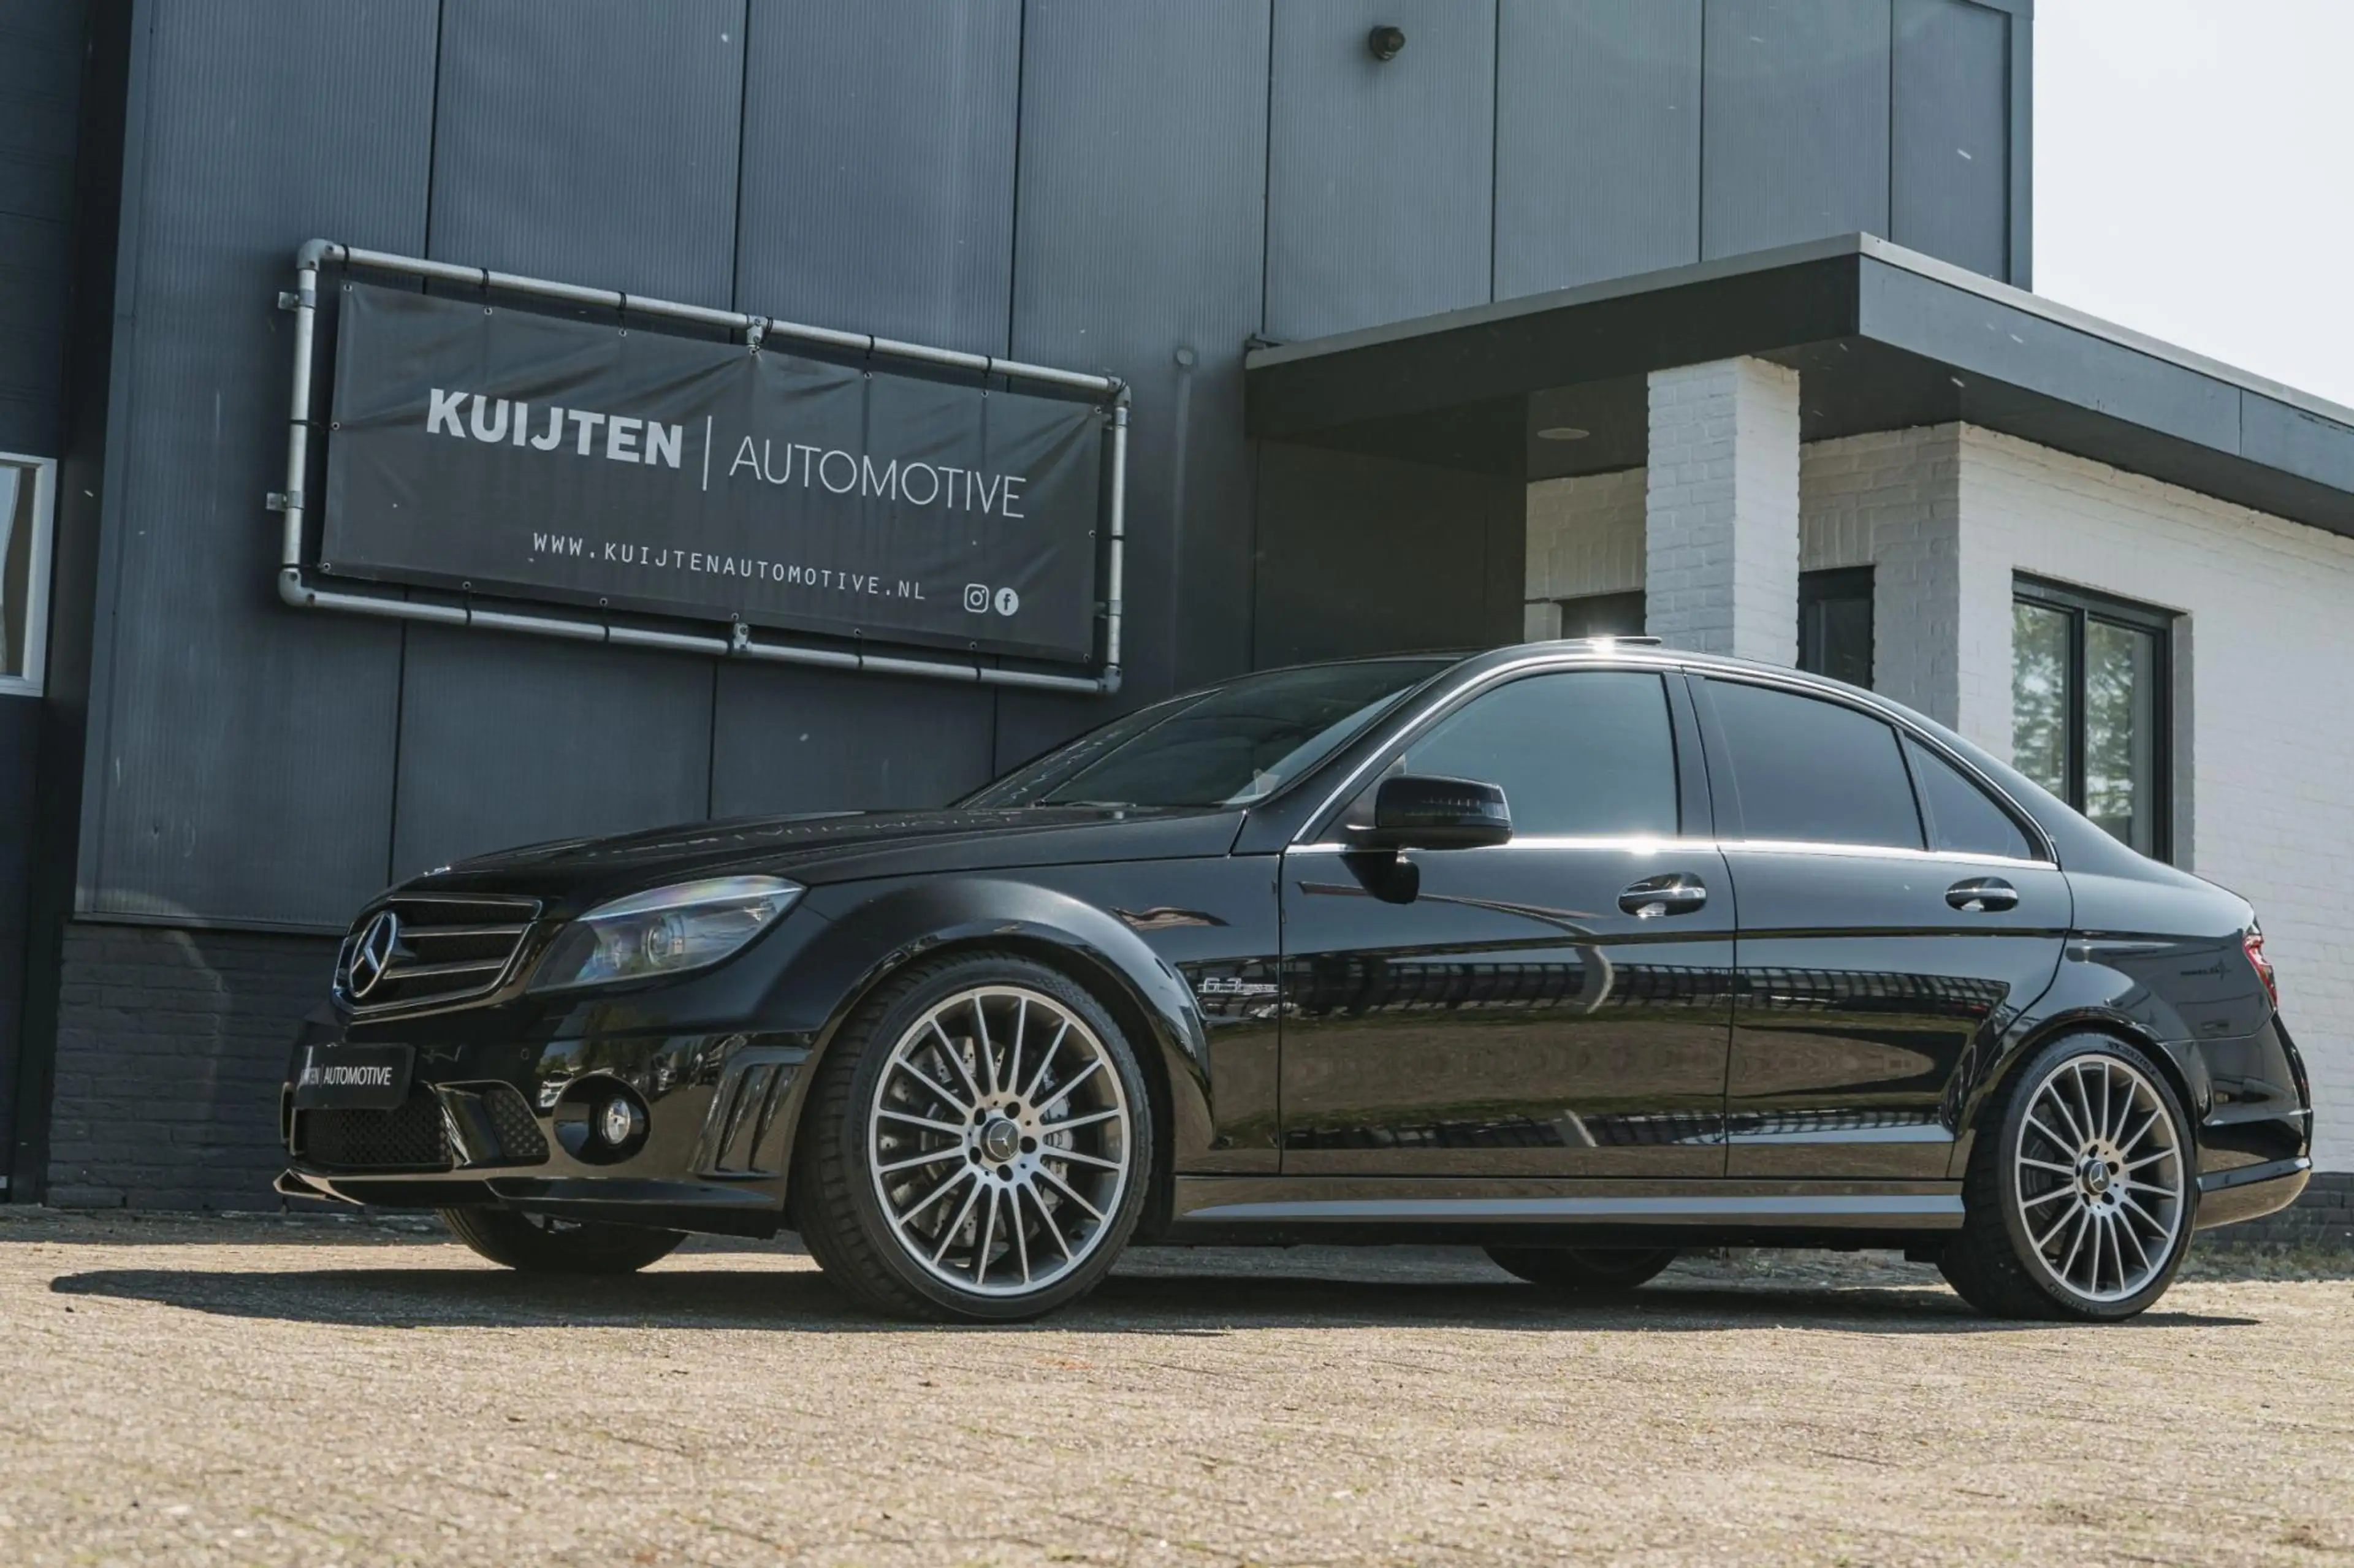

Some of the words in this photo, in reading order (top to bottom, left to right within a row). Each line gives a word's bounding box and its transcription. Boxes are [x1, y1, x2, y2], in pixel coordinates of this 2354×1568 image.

[427, 387, 683, 468] KUIJTEN
[728, 435, 1027, 519] AUTOMOTIVE
[533, 532, 925, 600] WWW.KUIJTENAUTOMOTIVE.NL
[323, 1065, 392, 1086] AUTOMOTIVE
